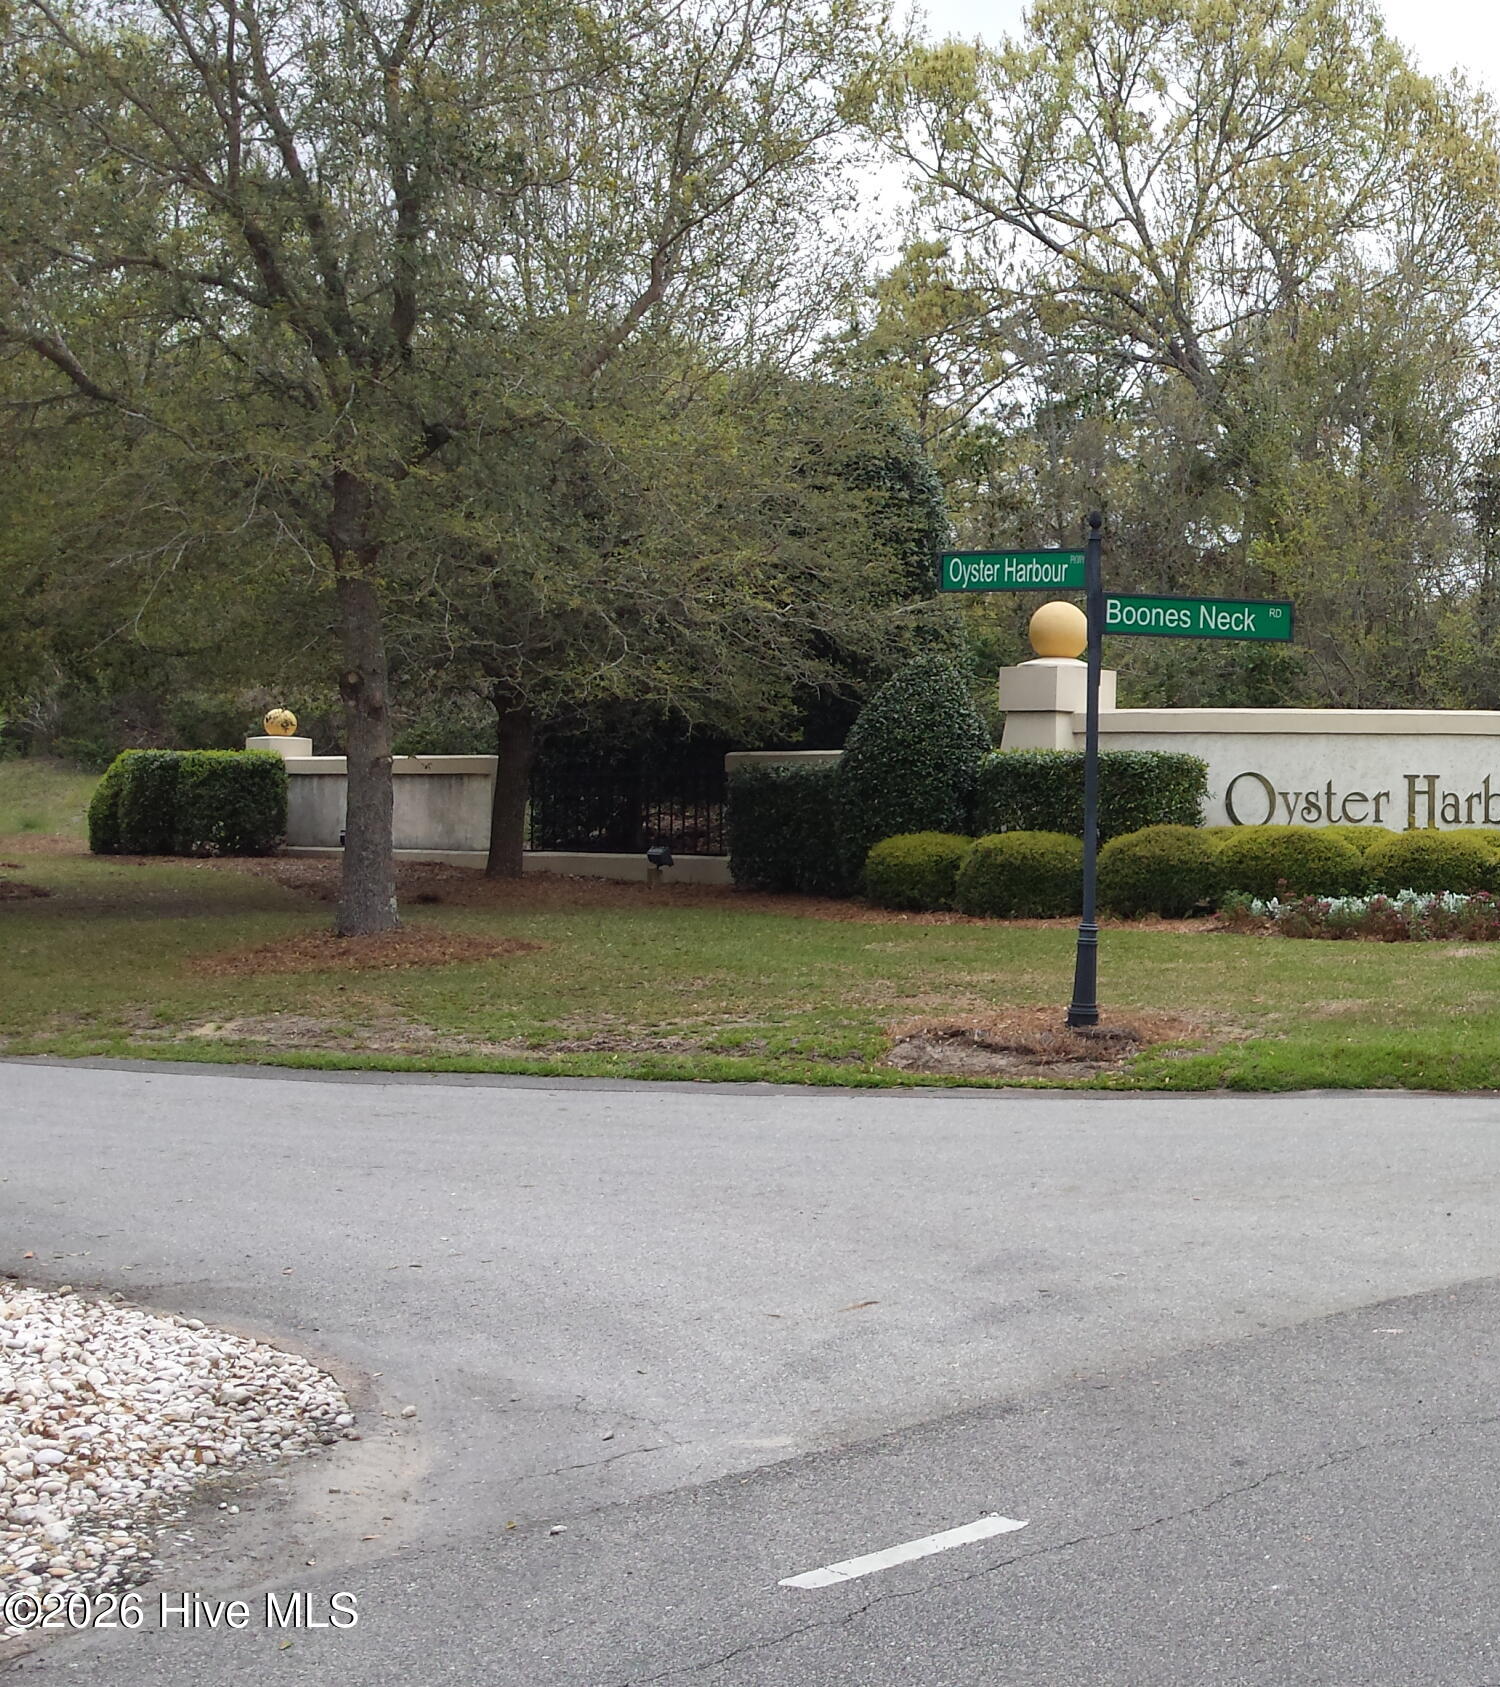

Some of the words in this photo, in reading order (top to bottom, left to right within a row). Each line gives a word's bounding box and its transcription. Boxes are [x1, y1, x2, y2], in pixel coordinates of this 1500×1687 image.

[949, 557, 999, 588] Oyster
[1004, 555, 1068, 583] Harbour
[1105, 599, 1191, 628] Boones
[1199, 605, 1256, 632] Neck
[1268, 608, 1282, 619] RD
[1225, 771, 1390, 826] Oyster
